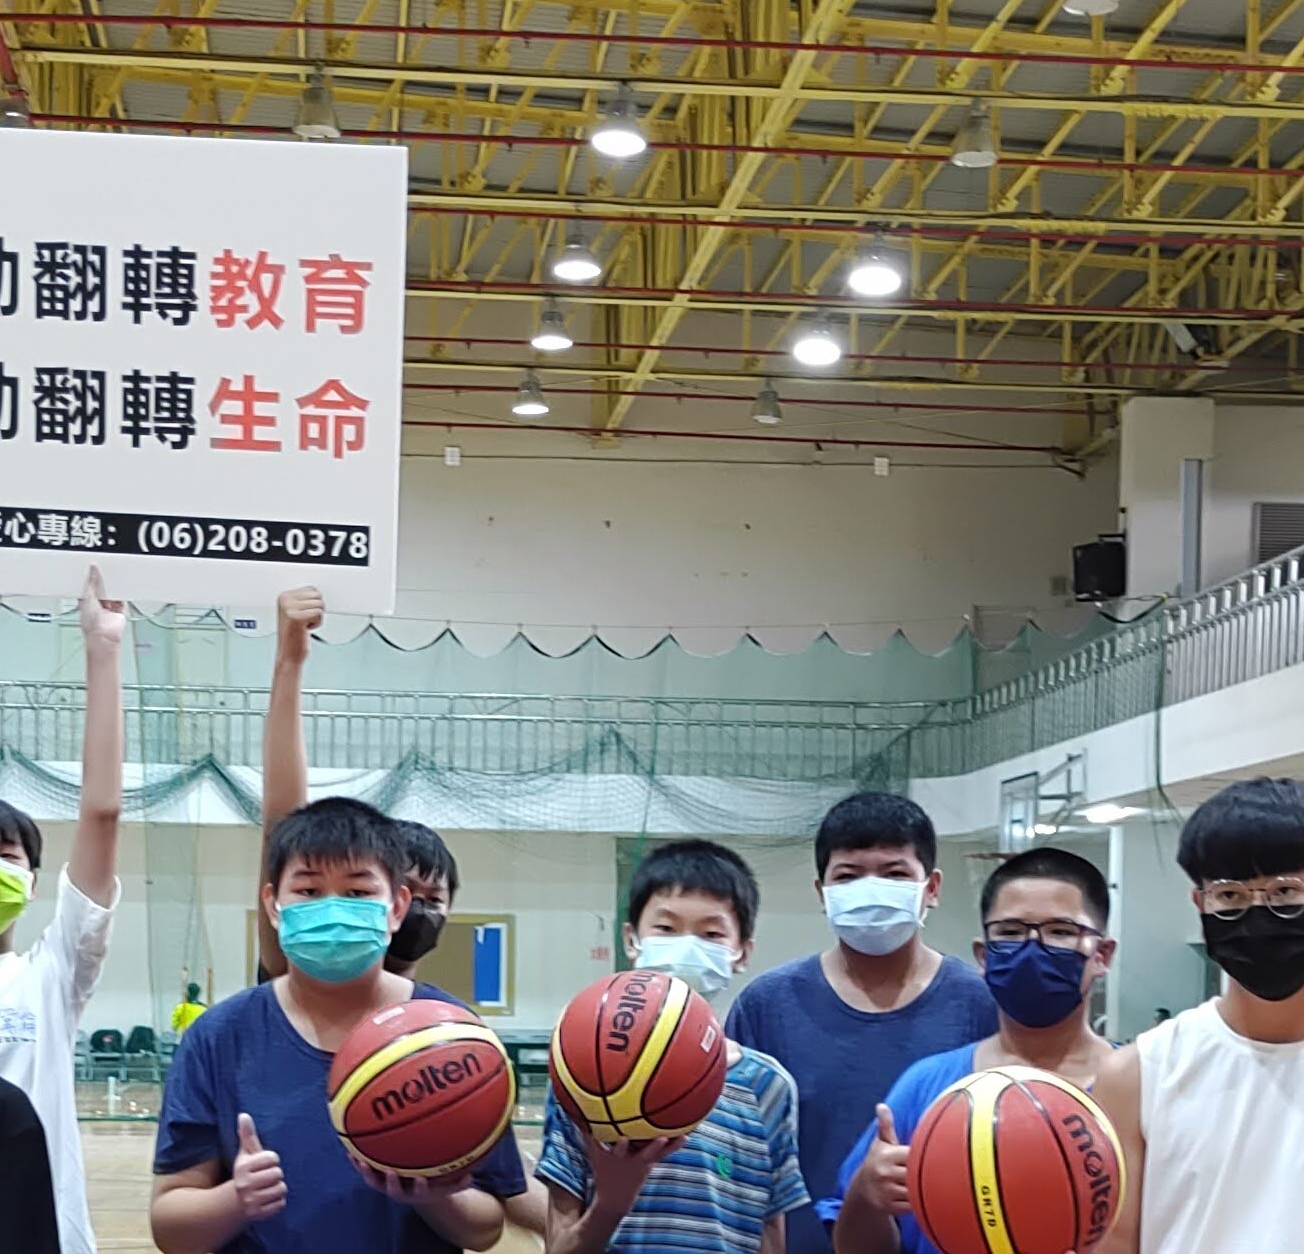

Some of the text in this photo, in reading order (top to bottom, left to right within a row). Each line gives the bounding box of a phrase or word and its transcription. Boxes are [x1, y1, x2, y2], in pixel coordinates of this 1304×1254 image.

[137, 521, 369, 560] (06)208-0378
[606, 971, 656, 1053] molten
[371, 1053, 483, 1120] molten
